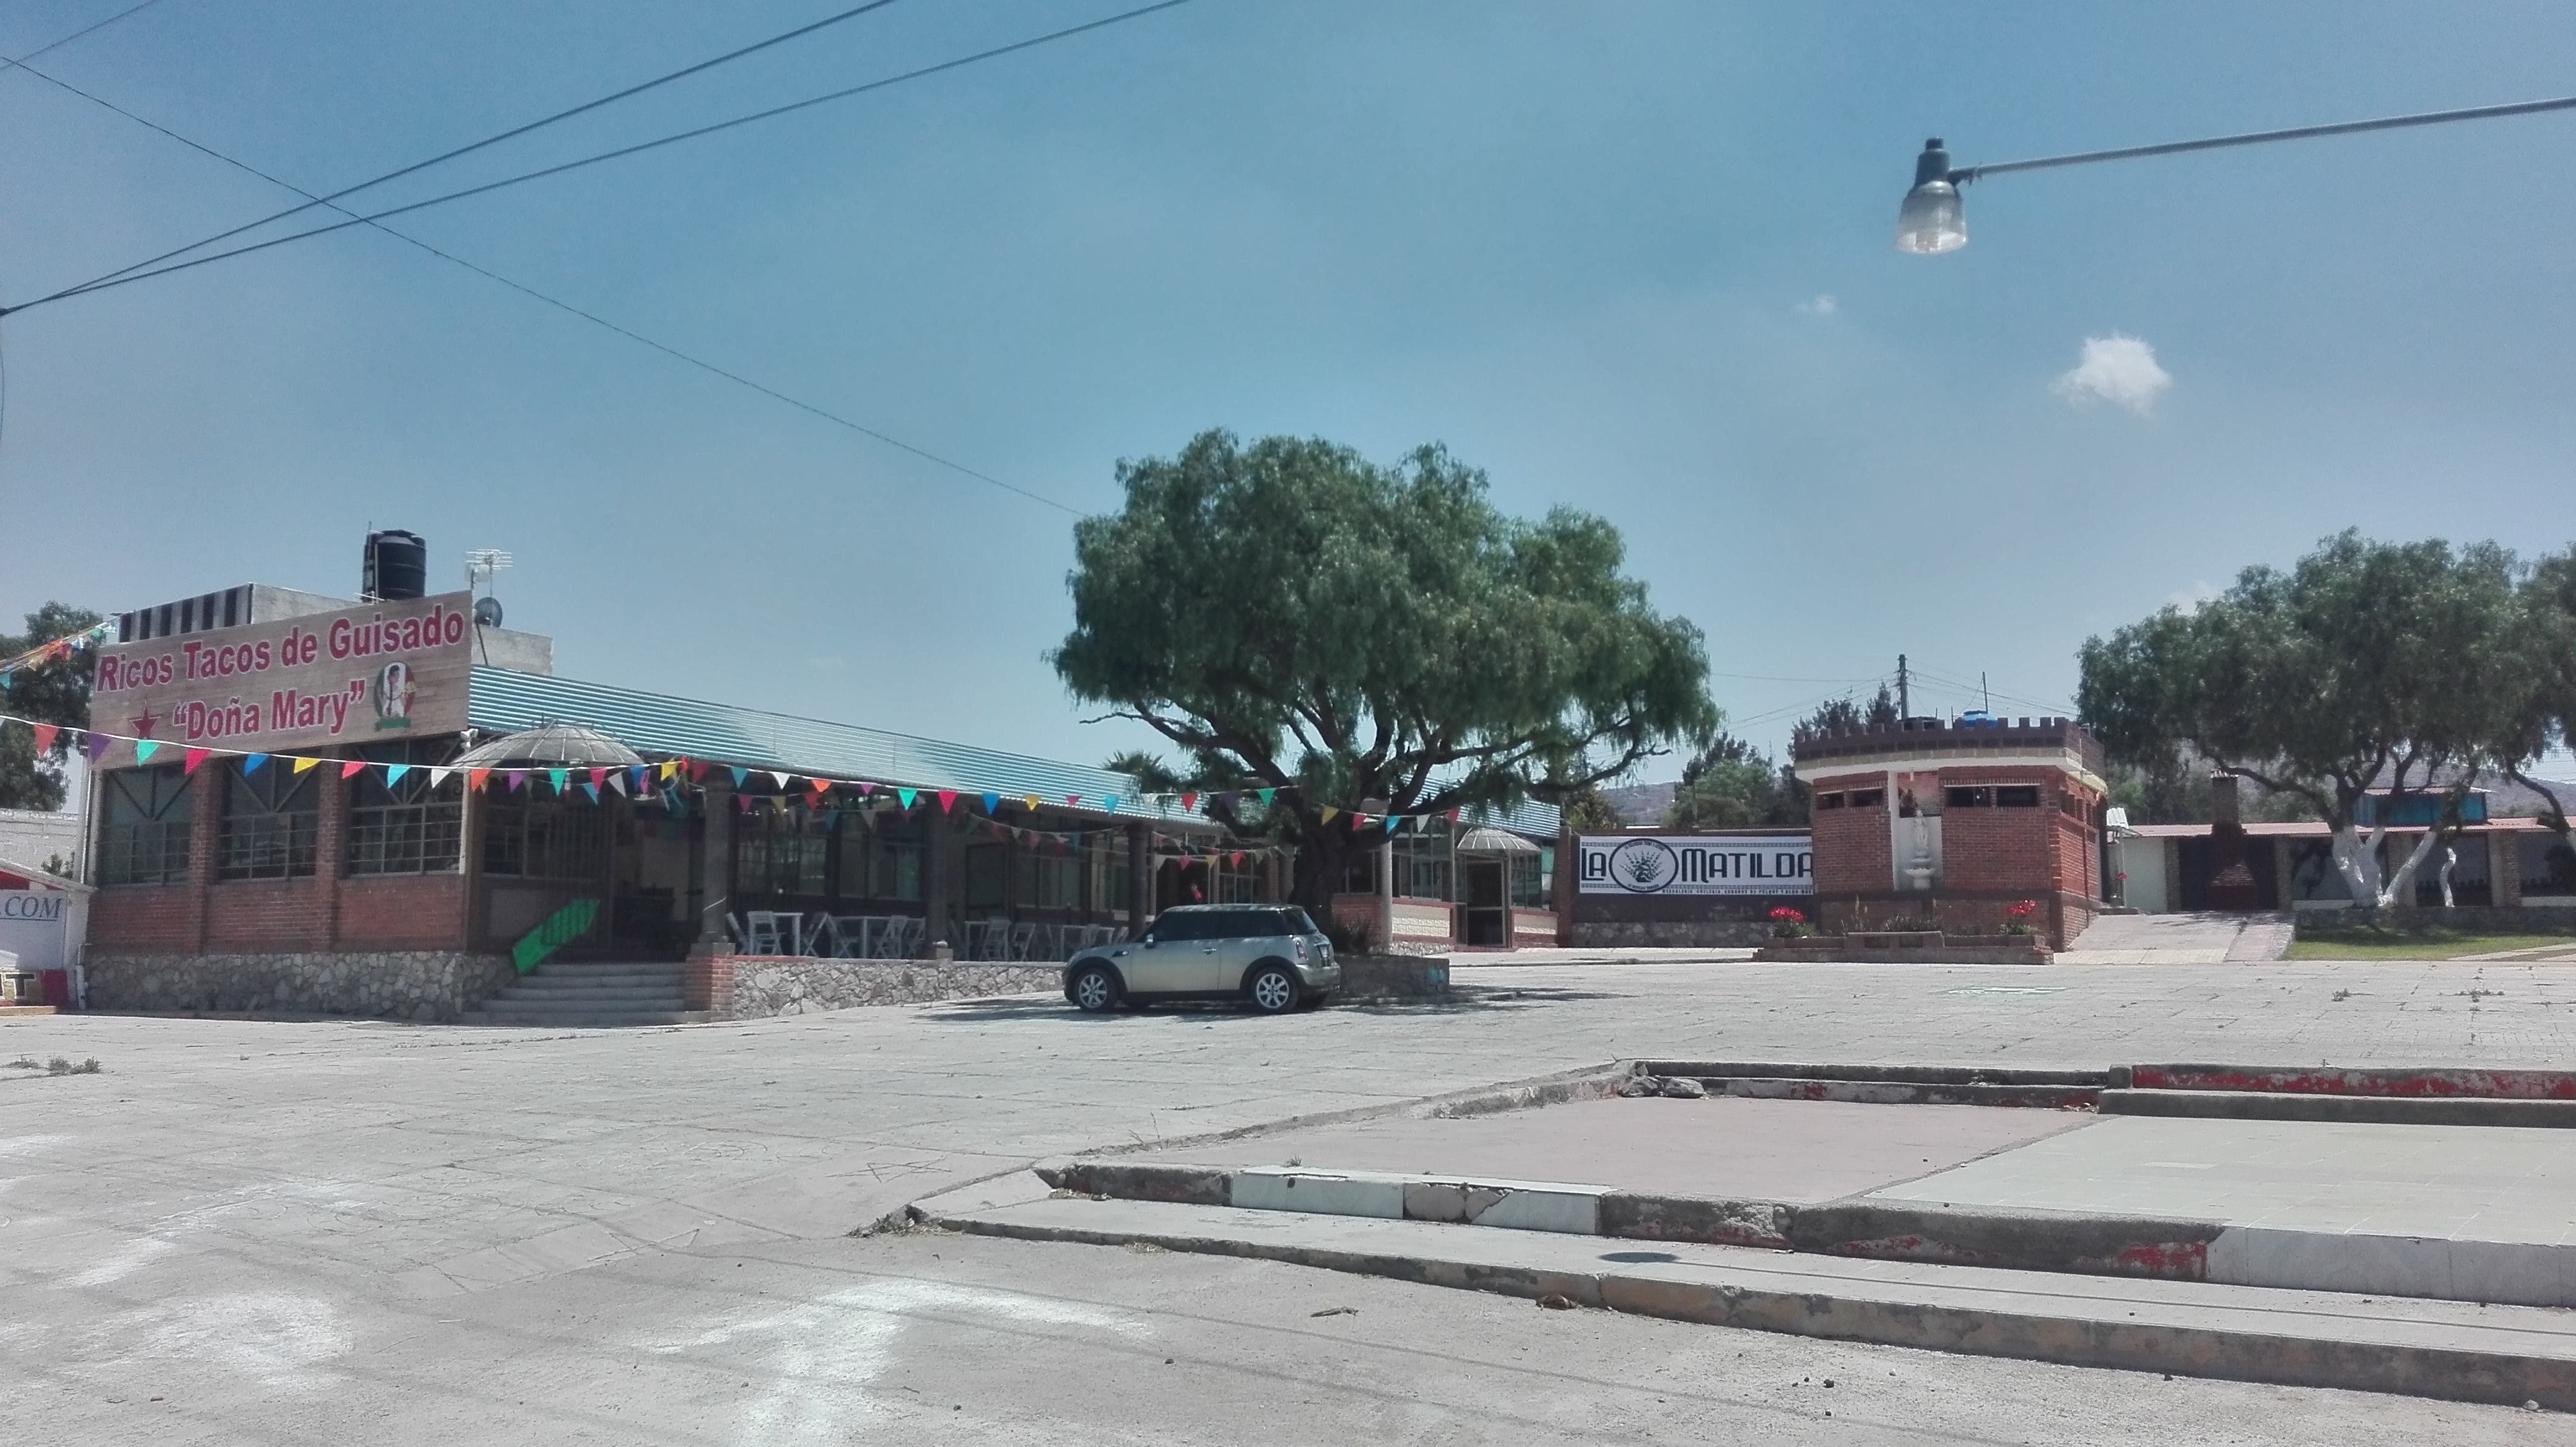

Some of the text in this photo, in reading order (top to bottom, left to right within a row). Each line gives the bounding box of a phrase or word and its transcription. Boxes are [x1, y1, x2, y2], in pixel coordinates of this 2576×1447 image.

[95, 603, 464, 692] Ricos Tacos de Guisado
[1581, 847, 1813, 883] LA MATILDA
